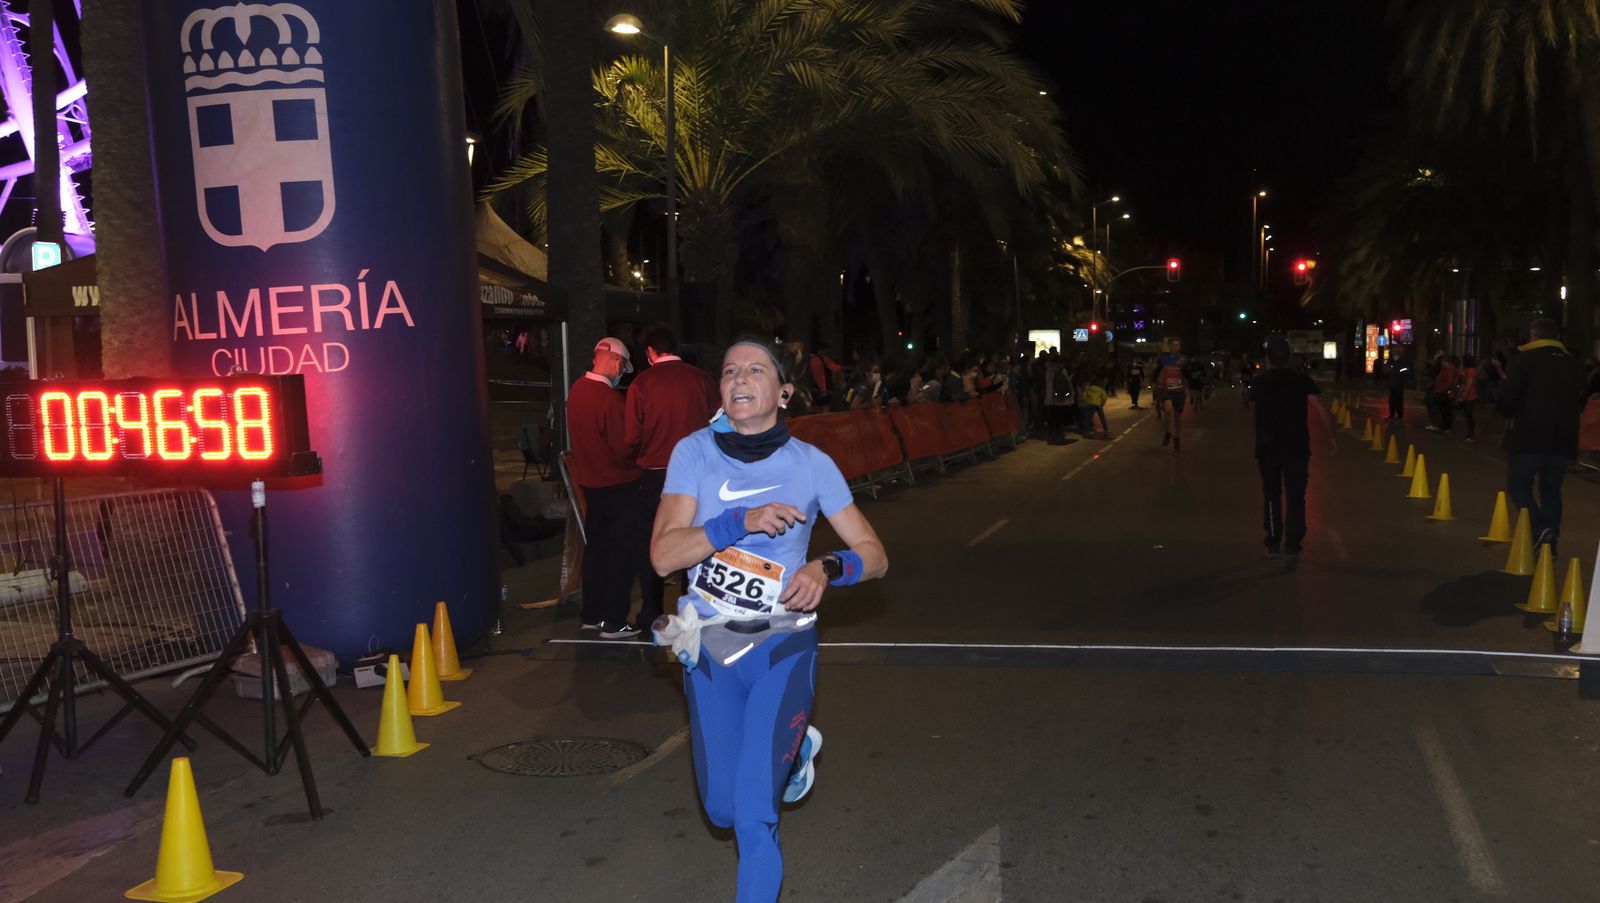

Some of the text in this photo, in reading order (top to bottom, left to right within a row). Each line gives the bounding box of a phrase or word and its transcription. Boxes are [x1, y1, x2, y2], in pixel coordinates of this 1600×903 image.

[38, 247, 56, 271] P
[173, 269, 415, 341] ALMERÍA
[211, 342, 350, 377] CIUDAD
[40, 387, 274, 461] 00:46:58
[712, 563, 766, 599] 526
